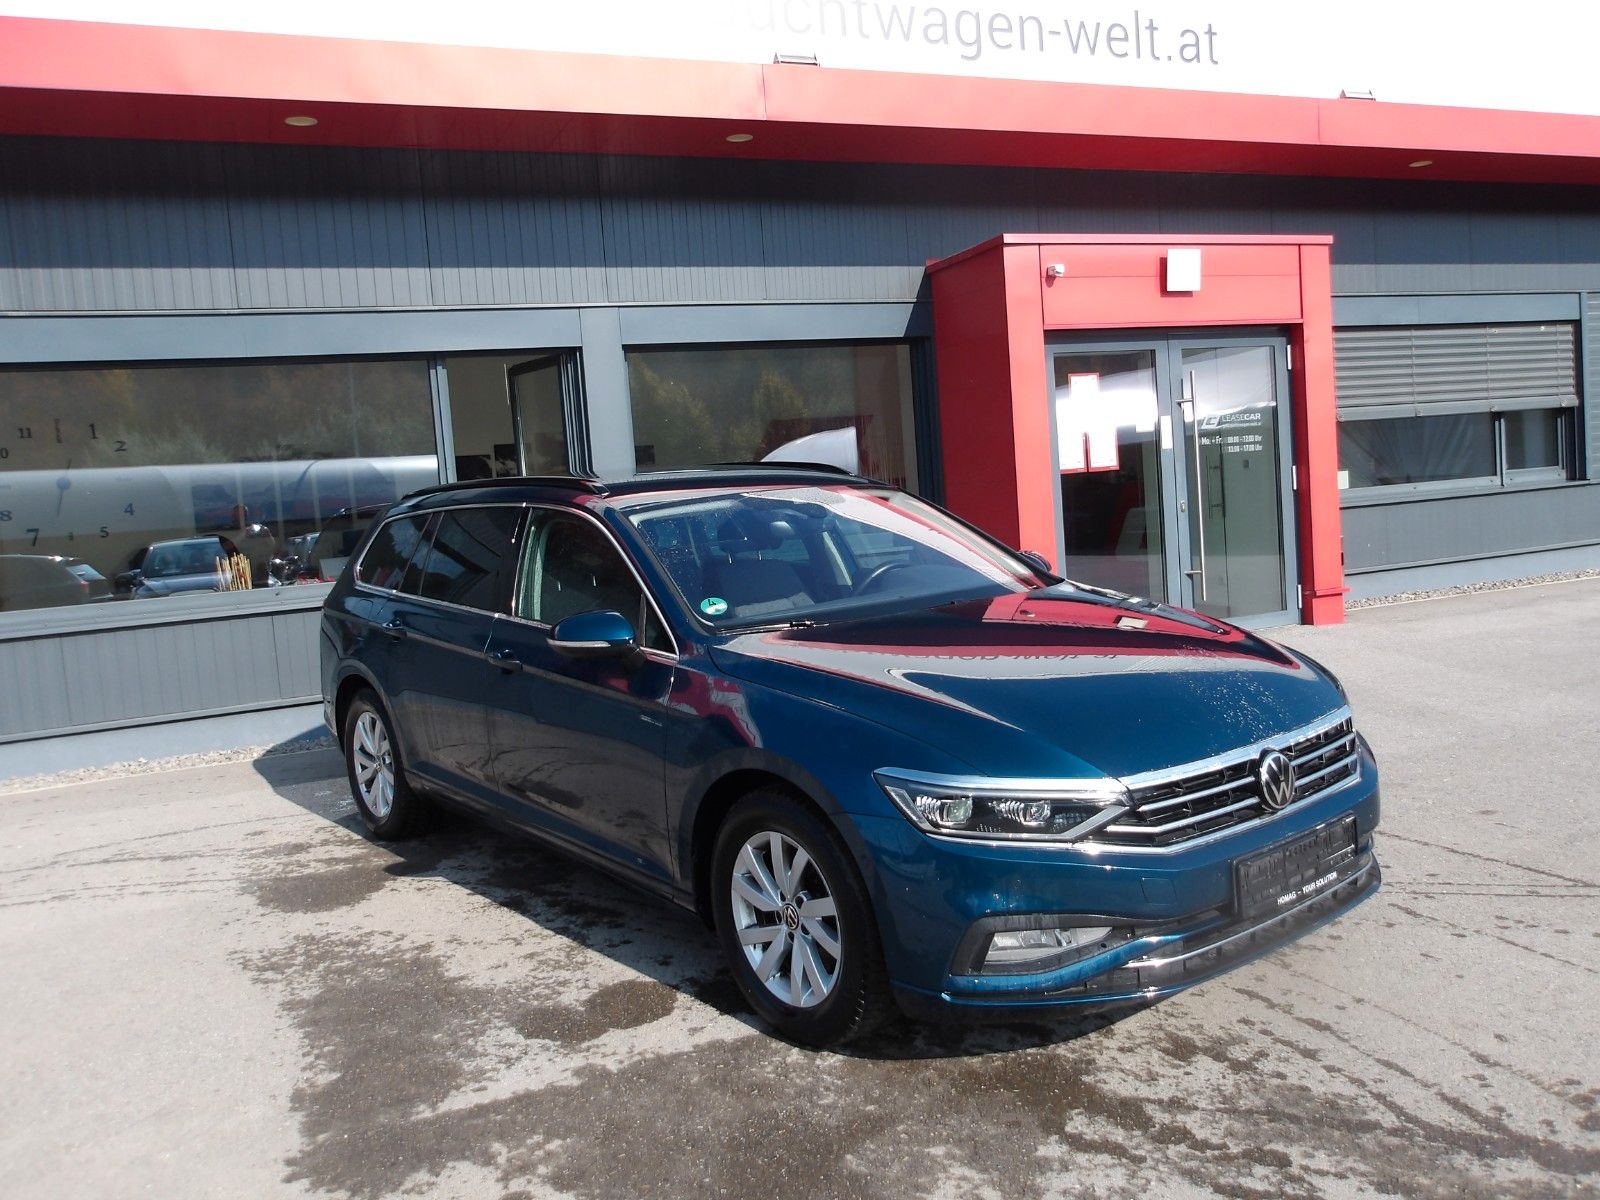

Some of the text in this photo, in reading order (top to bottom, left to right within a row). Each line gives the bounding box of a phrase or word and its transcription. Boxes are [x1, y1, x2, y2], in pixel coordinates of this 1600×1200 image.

[0, 447, 9, 459] 0
[114, 440, 127, 453] 2
[123, 502, 136, 516] 4
[26, 527, 40, 547] 7
[100, 526, 110, 538] 5
[1302, 882, 1316, 895] YOUR
[1316, 871, 1337, 887] SOLUTION
